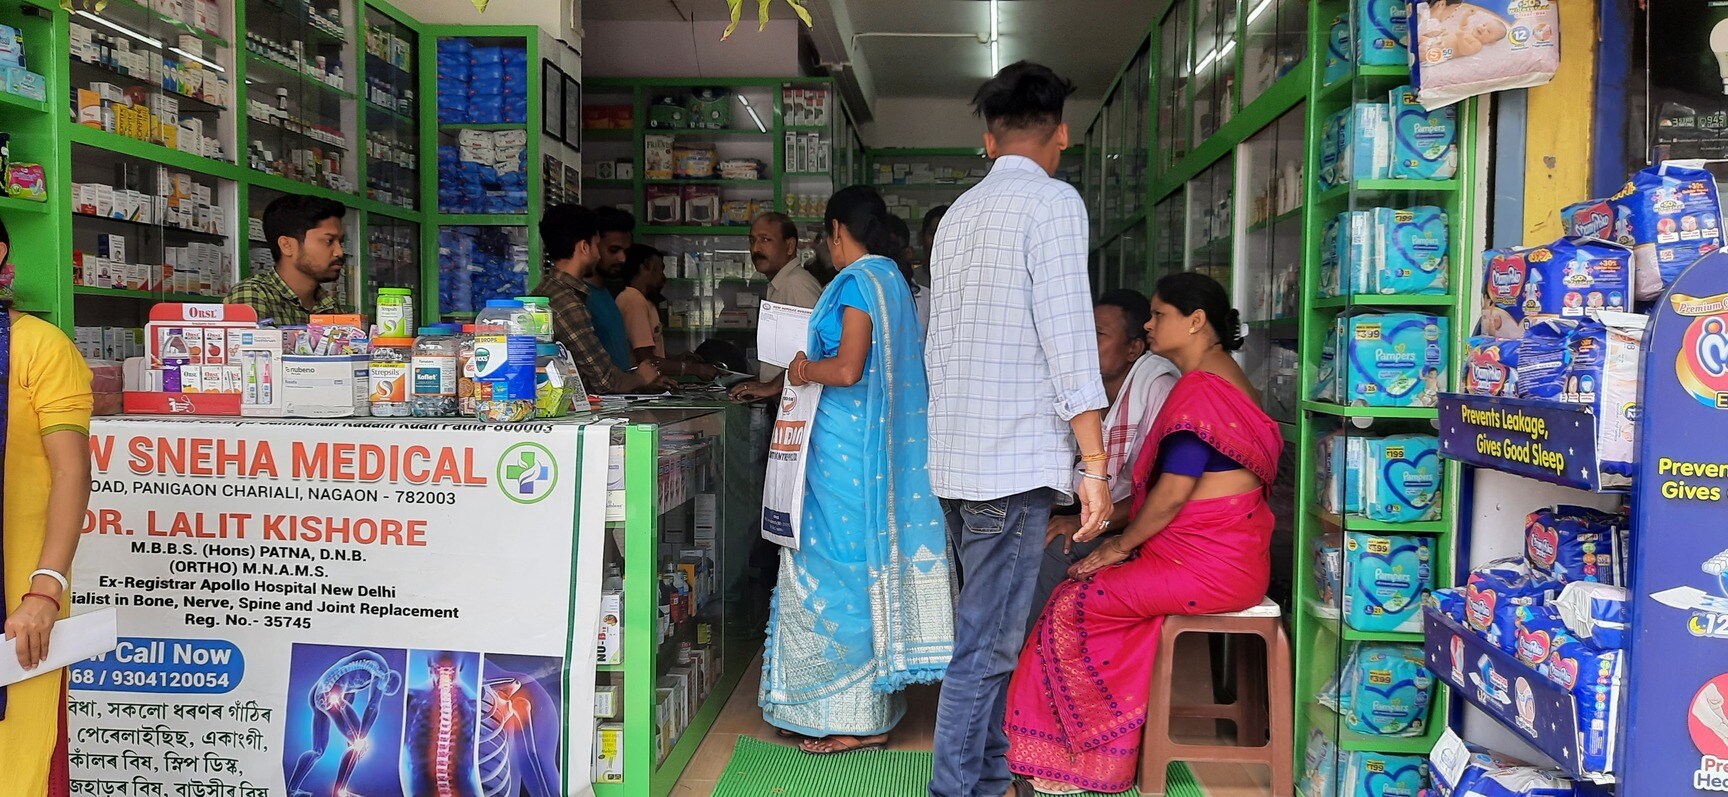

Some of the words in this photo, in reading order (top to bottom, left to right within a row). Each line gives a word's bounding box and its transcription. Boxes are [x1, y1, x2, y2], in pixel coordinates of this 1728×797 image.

[1514, 32, 1527, 40] 12
[1413, 123, 1446, 134] Pampers
[1679, 301, 1721, 314] Premium
[1375, 349, 1417, 363] Pampers
[1717, 394, 1728, 407] E
[1462, 404, 1500, 428] Prevents
[1502, 409, 1549, 440] Leakage,
[128, 436, 278, 478] SNEHA
[292, 441, 487, 484] MEDICAL
[1476, 433, 1501, 457] Gives
[1503, 438, 1530, 464] Good
[1532, 444, 1565, 476] Sleep
[133, 481, 217, 497] PANIGAON
[222, 484, 303, 501] CHARIALI,
[308, 487, 378, 503] NAGAON
[395, 490, 456, 505] 782003
[1661, 481, 1721, 501] Gives
[148, 510, 252, 539] LALIT
[263, 514, 428, 547] KISHORE
[131, 541, 198, 555] M.B.B.S.
[202, 543, 256, 559] (Hons)
[260, 546, 315, 561] PATNA,
[320, 549, 367, 562] D.N.B.
[169, 560, 238, 575] (ORTHO)
[242, 562, 329, 578] M.N.A.M.S.
[1375, 568, 1411, 583] Pampers
[99, 576, 196, 591] Ex-Registrar
[201, 579, 250, 593] Apollo
[254, 580, 317, 596] Hospital
[321, 583, 353, 596] New
[357, 585, 396, 598] Delhi
[71, 592, 110, 605] ialist
[114, 593, 129, 606] in
[133, 594, 179, 609] Bone,
[184, 596, 234, 611] Nerve,
[238, 597, 281, 612] Spine
[285, 600, 313, 612] and
[317, 601, 355, 614] Joint
[360, 603, 459, 619] Replacement
[185, 613, 220, 628] Reg.
[225, 614, 259, 627] No.-
[264, 615, 311, 629] 35745
[115, 641, 165, 664] Call
[173, 643, 232, 665] Now
[70, 669, 94, 685] 68
[98, 670, 107, 686] /
[111, 670, 229, 688] 9304120054
[107, 702, 168, 720] সকলো
[173, 701, 224, 721] ধৰণৰ
[201, 727, 268, 752] একাংগী,
[122, 749, 159, 773] বিষ,
[203, 751, 243, 777] ডিস্ক,
